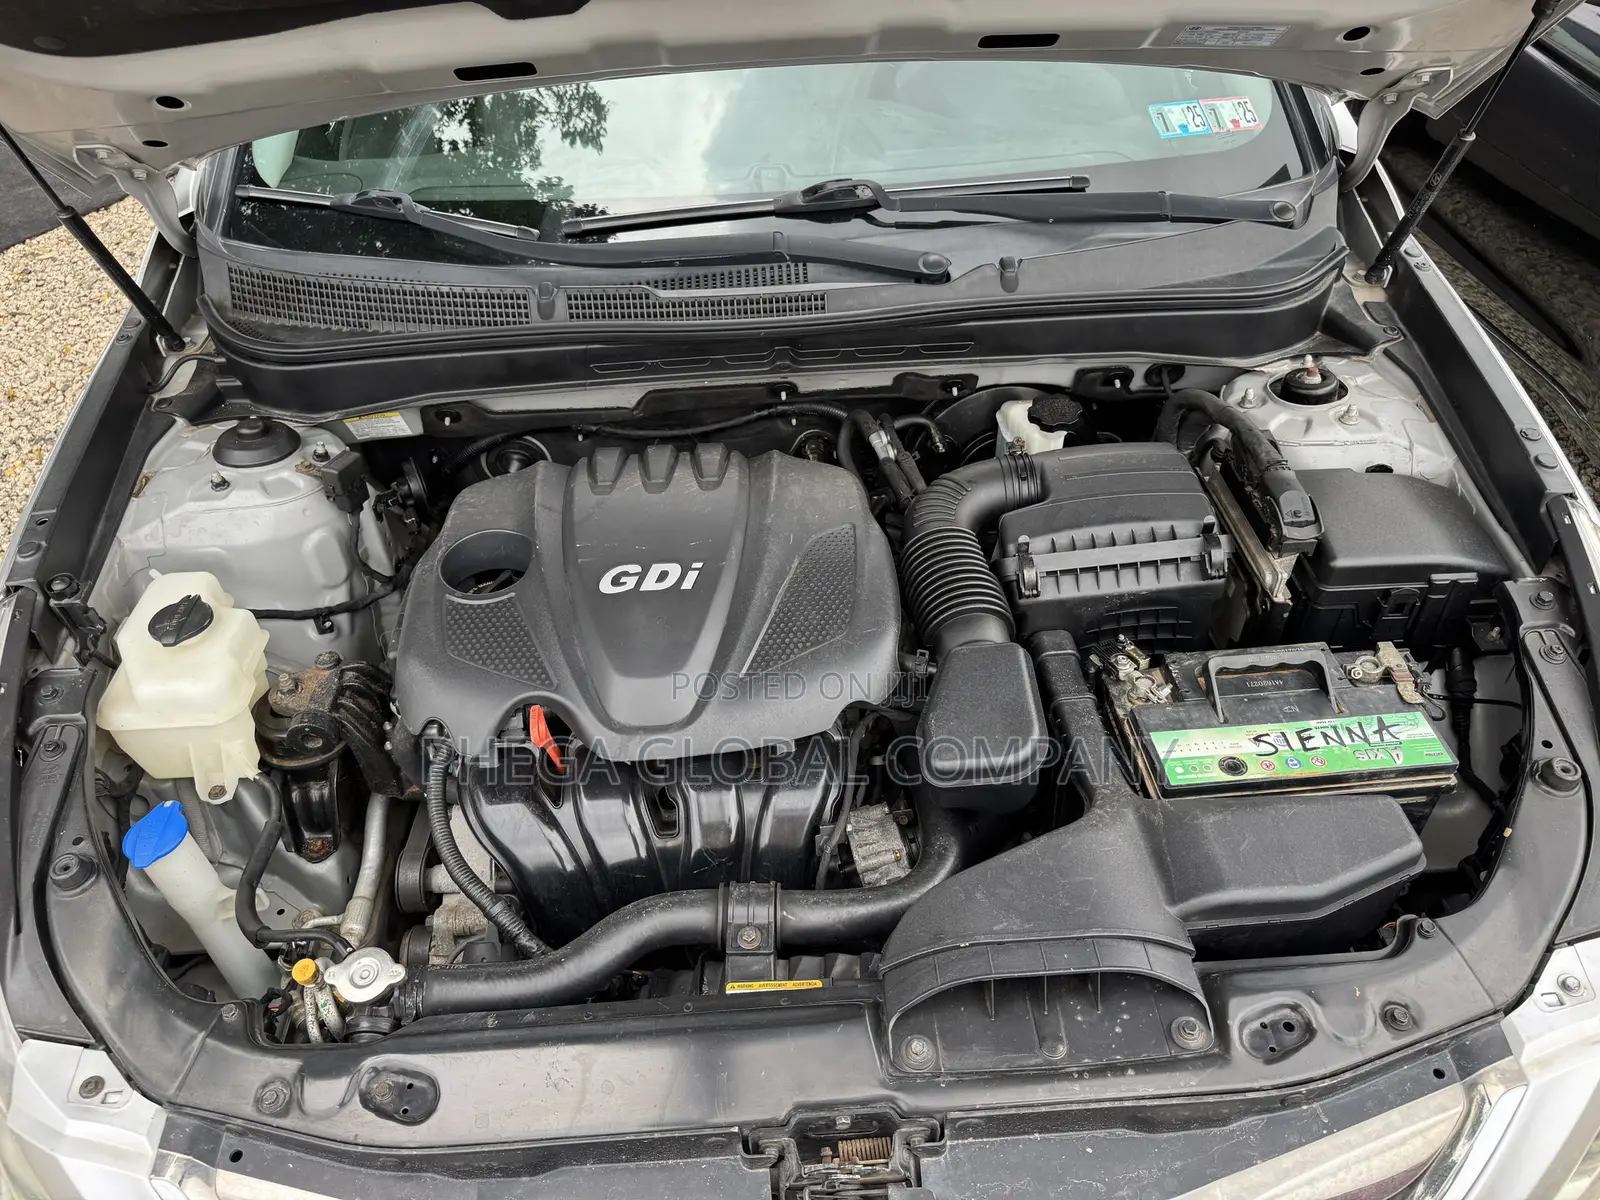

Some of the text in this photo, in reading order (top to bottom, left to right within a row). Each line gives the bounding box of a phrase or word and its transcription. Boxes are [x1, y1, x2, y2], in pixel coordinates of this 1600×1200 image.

[1186, 105, 1206, 128] 25
[1238, 100, 1257, 123] 25
[599, 562, 704, 594] GDi
[1250, 715, 1401, 757] SIENNA
